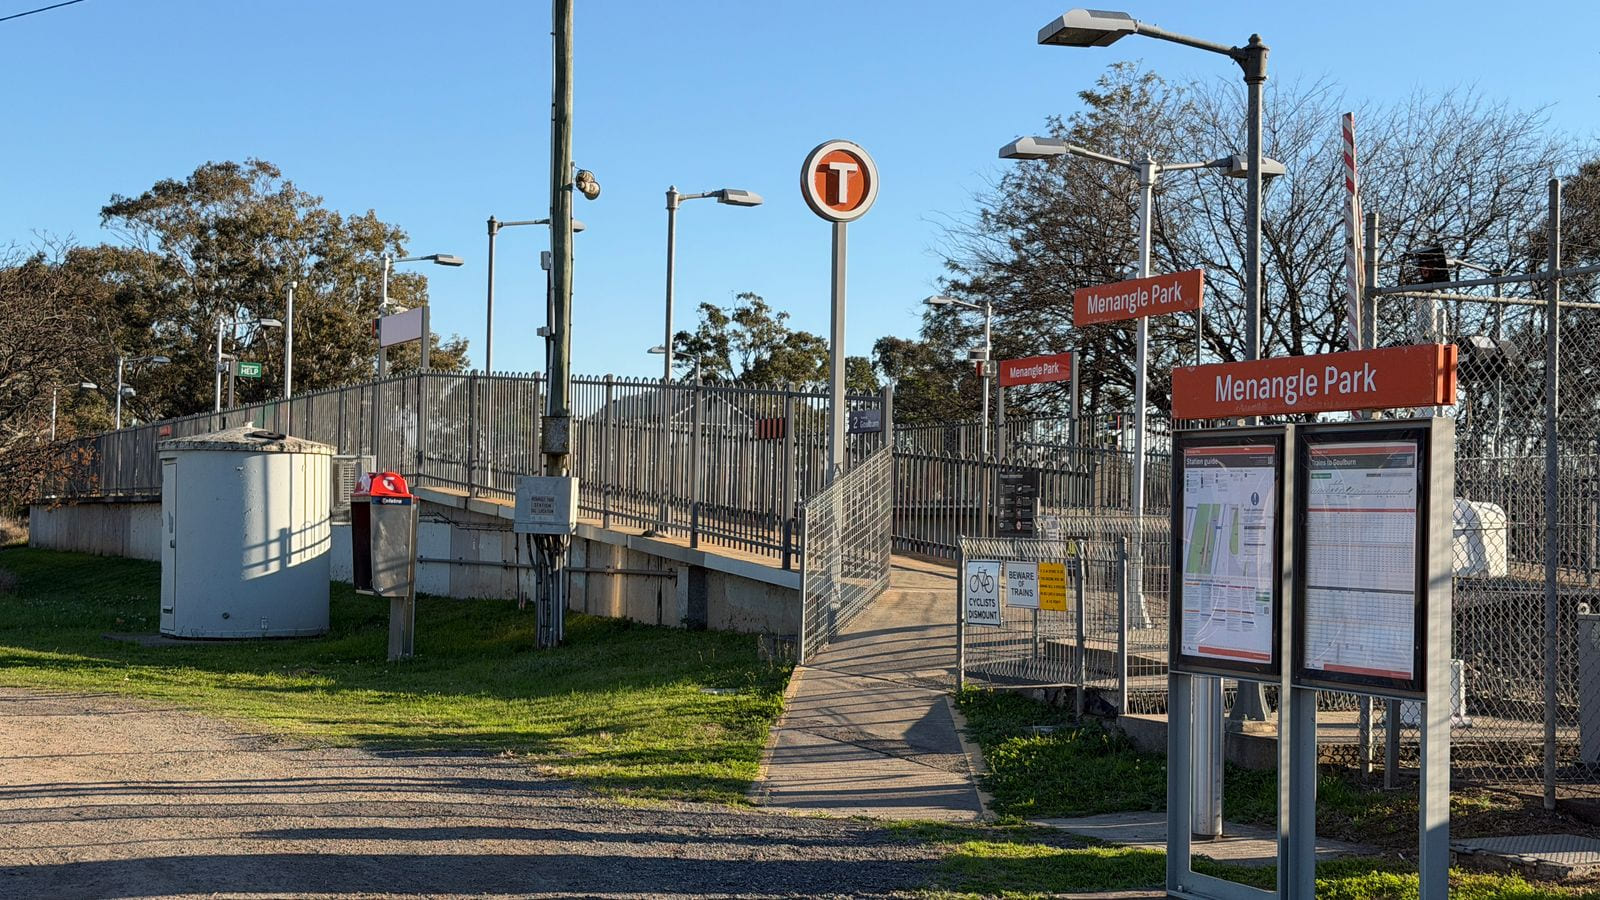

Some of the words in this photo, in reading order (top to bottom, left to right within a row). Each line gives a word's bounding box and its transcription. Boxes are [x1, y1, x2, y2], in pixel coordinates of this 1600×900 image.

[829, 161, 858, 204] T
[1087, 287, 1148, 314] Menangle
[1151, 280, 1182, 305] Park
[240, 367, 259, 375] HELP
[985, 363, 992, 374] 1
[1009, 364, 1043, 379] Menangle
[1043, 362, 1060, 375] Park
[1215, 367, 1318, 406] Menangle
[1324, 362, 1377, 394] Park
[853, 417, 858, 429] 2
[1186, 457, 1204, 465] Station
[1204, 456, 1219, 466] guide
[1332, 458, 1357, 466] Goulburn
[1009, 571, 1035, 581] BEWARE
[1017, 580, 1025, 588] OF
[1011, 588, 1034, 597] TRAINS
[968, 598, 996, 608] CYCLISTS
[968, 610, 997, 620] DISMOUNT
